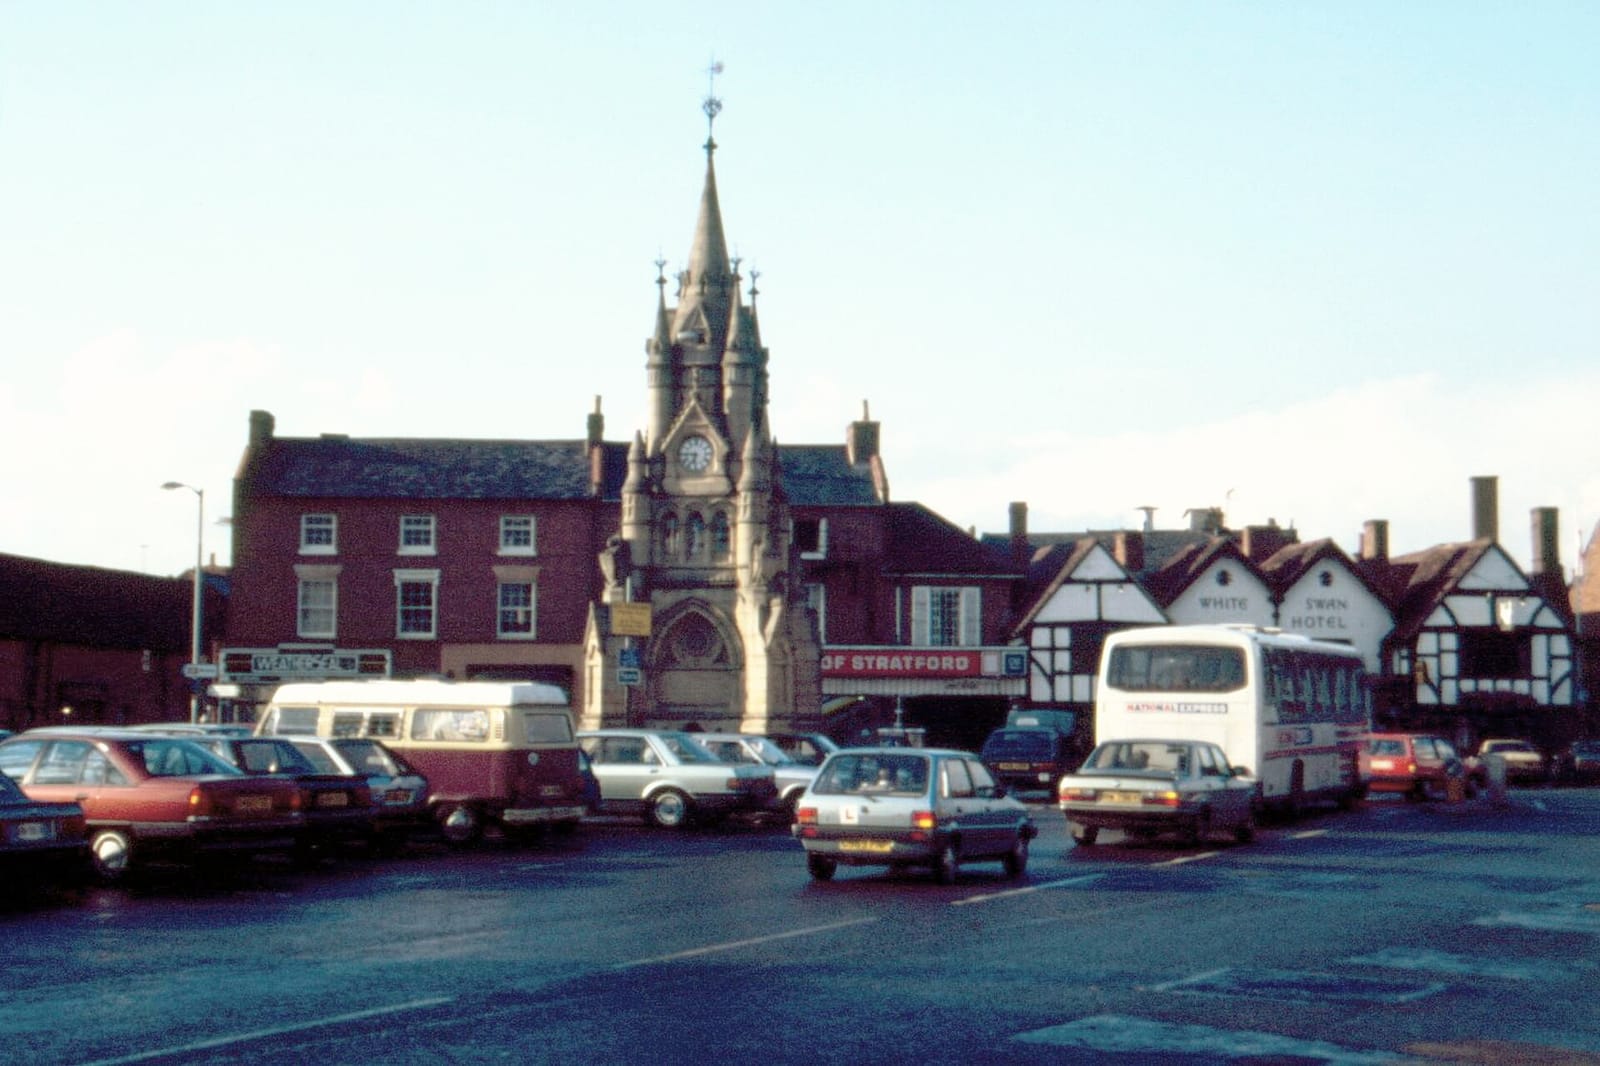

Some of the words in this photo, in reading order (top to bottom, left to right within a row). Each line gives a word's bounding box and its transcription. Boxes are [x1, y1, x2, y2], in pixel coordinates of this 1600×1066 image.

[1200, 598, 1248, 610] WHITE
[1305, 598, 1348, 610] SWAN
[1291, 616, 1347, 629] HOTEL
[821, 655, 846, 670] OF
[851, 655, 970, 671] STRATFORD
[1126, 702, 1176, 713] NATIONAL
[1179, 703, 1227, 713] EXPRESS
[845, 808, 855, 820] L
